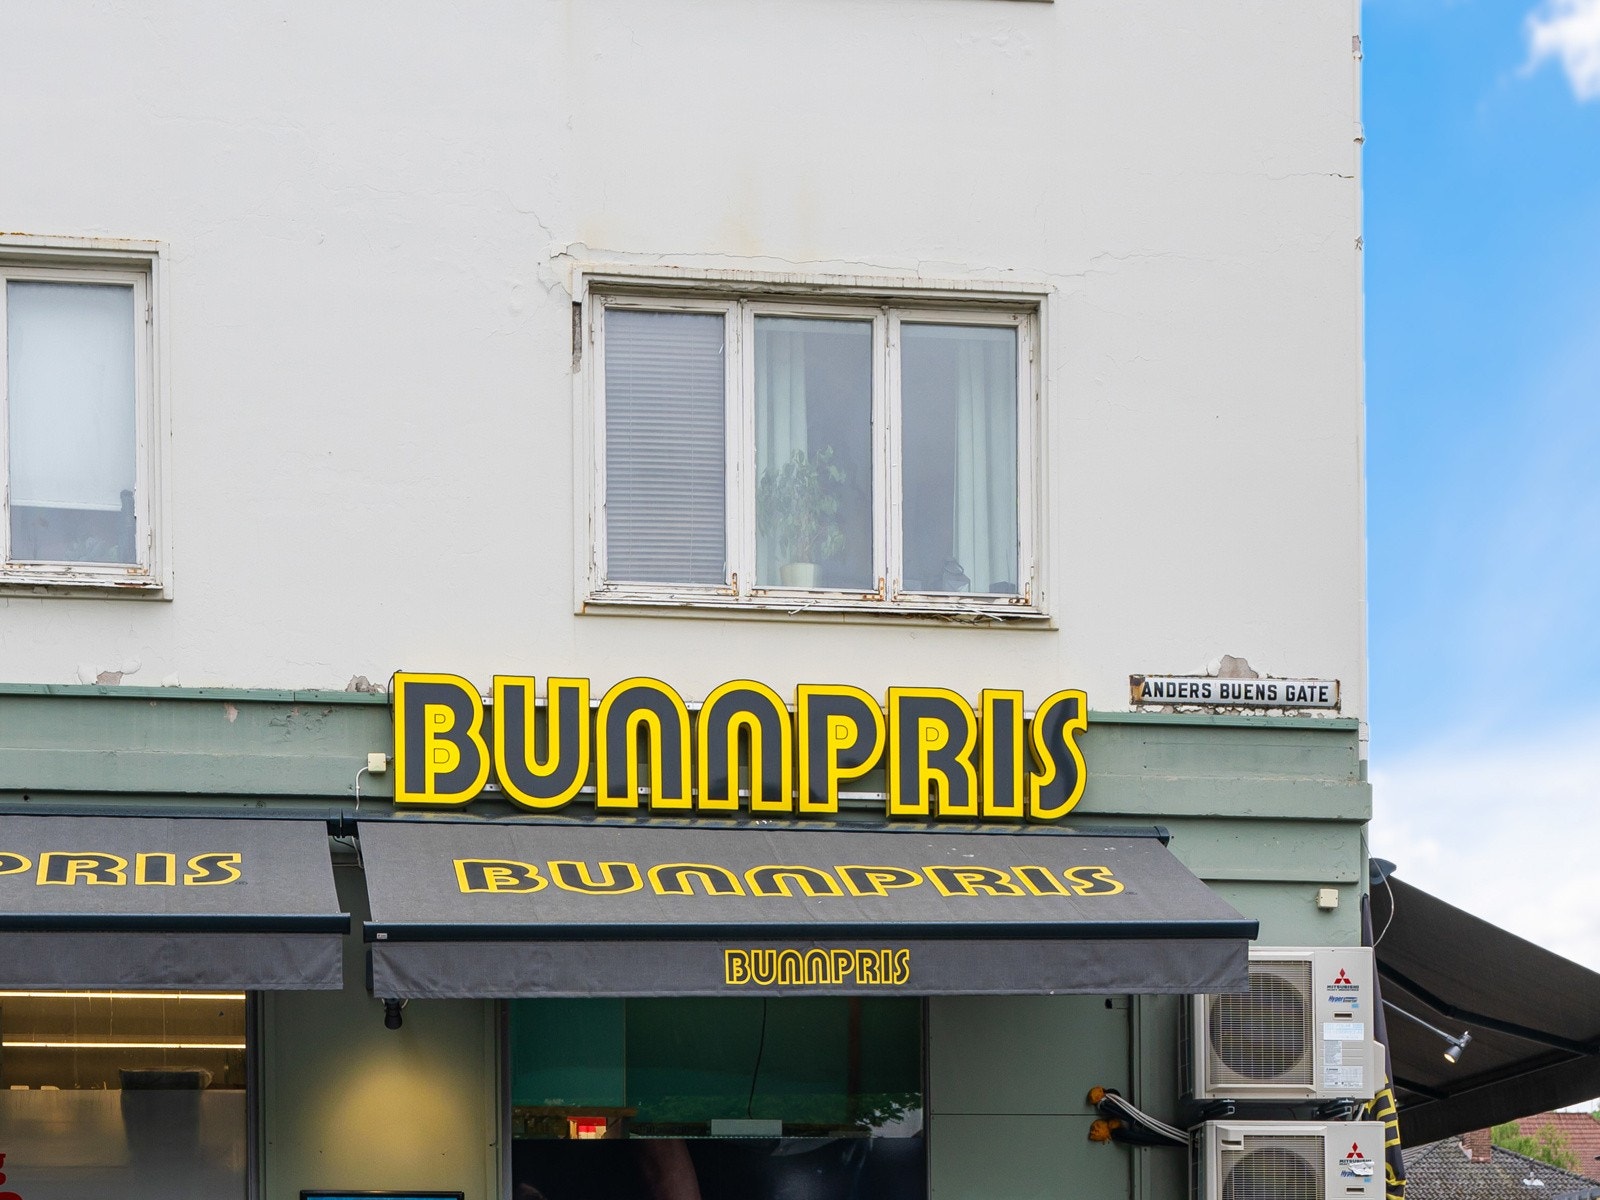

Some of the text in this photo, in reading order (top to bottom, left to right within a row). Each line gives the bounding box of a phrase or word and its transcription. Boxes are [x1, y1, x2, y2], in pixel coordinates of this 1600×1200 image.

[1142, 682, 1328, 702] ANDERS BUENS GATE
[393, 672, 1087, 822] BUNNPRIS
[453, 858, 1125, 897] BUNNPRIS
[725, 948, 909, 984] BUNNPRIS
